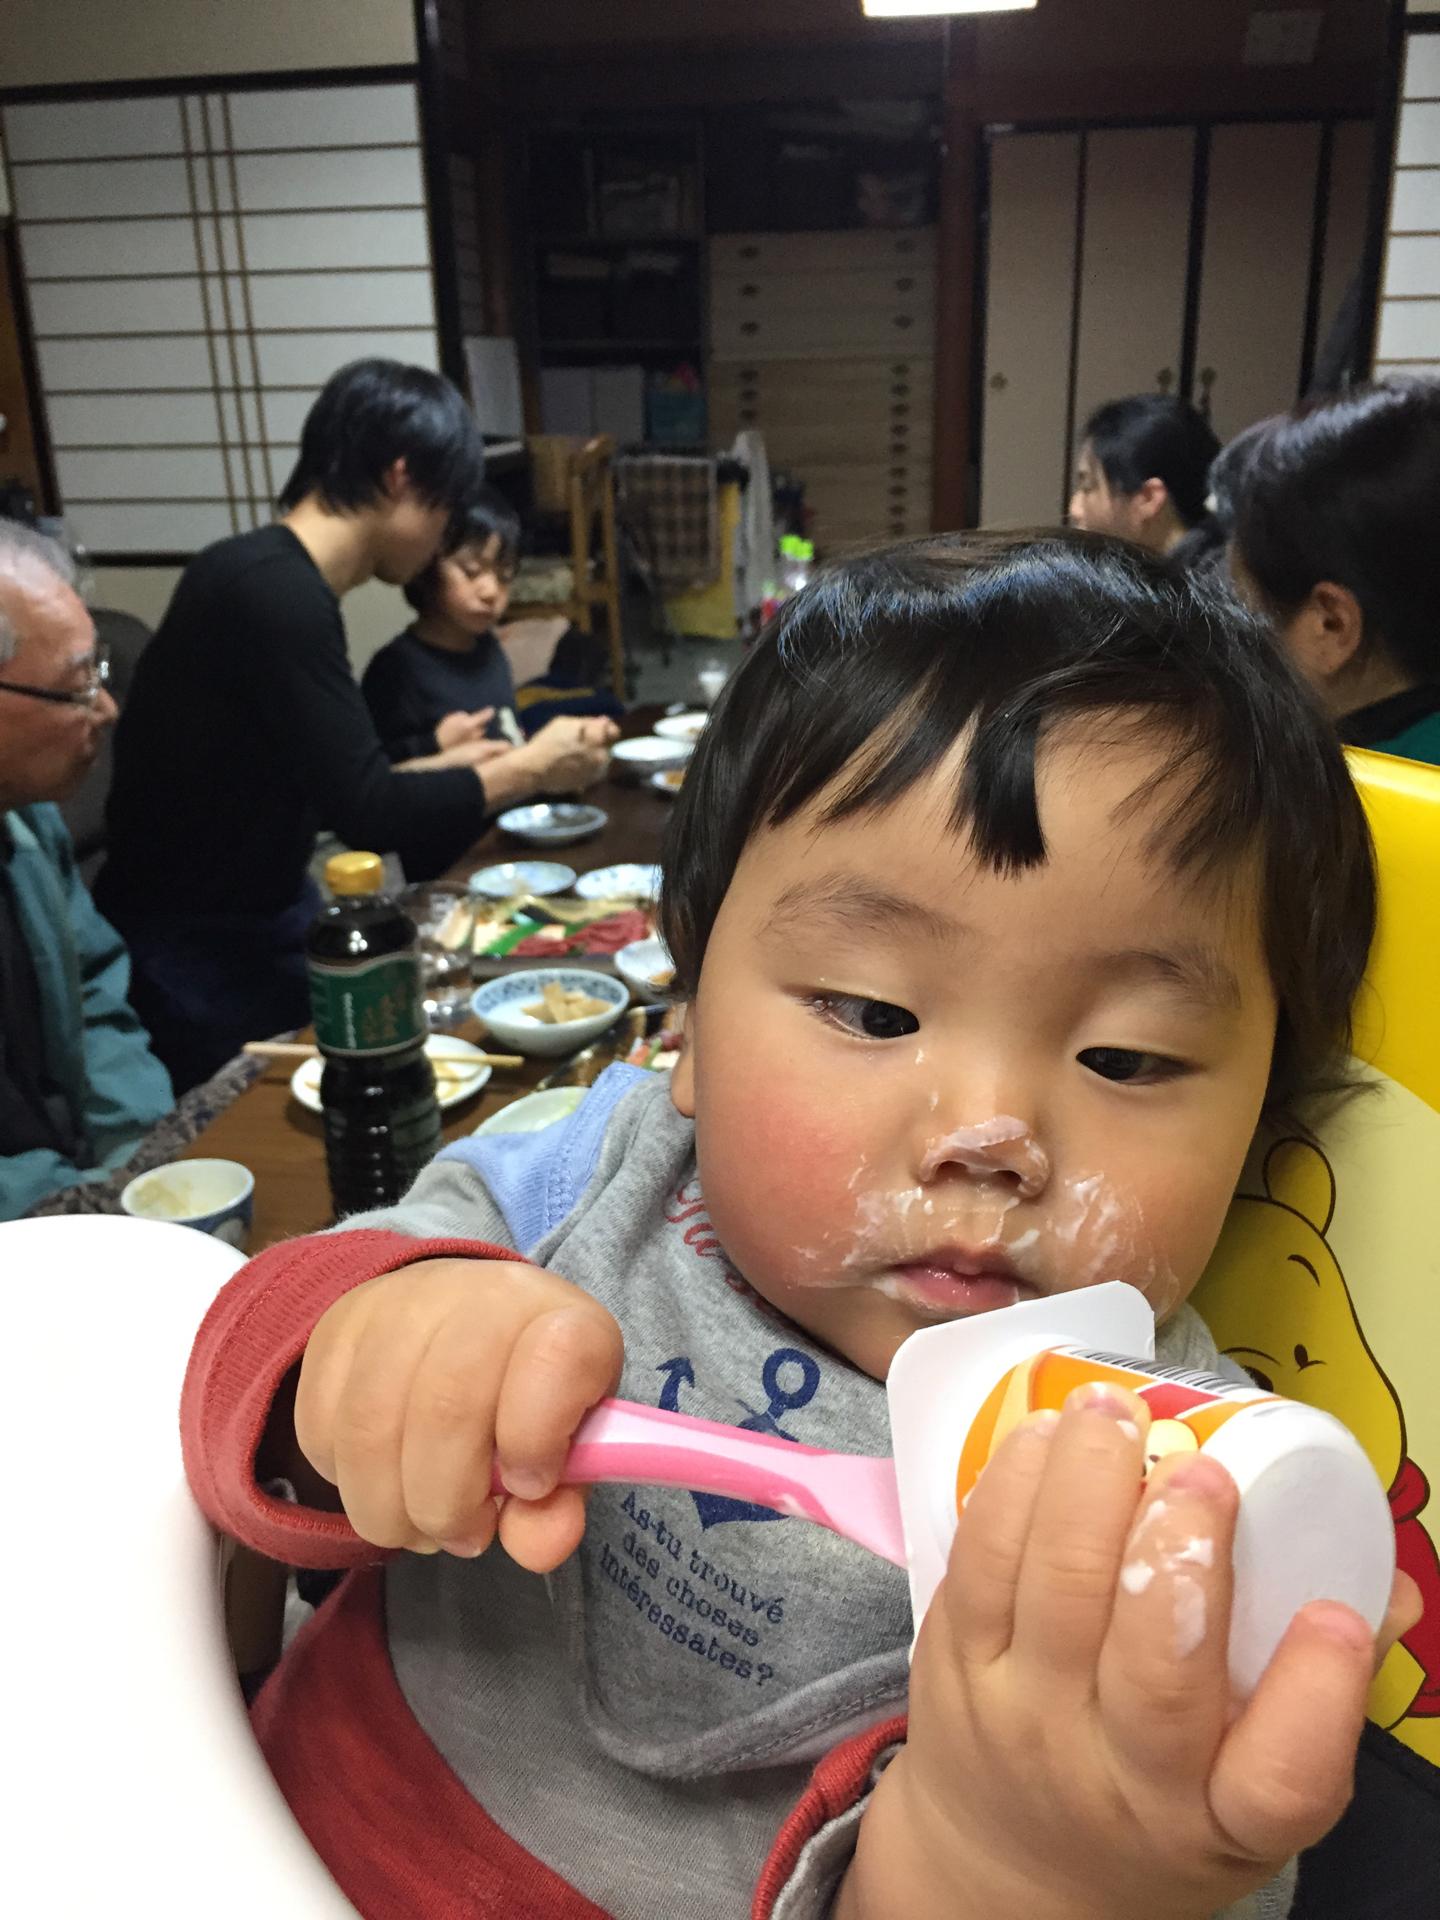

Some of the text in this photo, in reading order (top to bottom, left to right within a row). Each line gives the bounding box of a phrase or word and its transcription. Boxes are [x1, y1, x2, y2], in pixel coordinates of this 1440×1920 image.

[601, 1543, 774, 1686] intéressates?
[623, 1532, 759, 1647] des choses
[690, 1550, 784, 1624] trouvé
